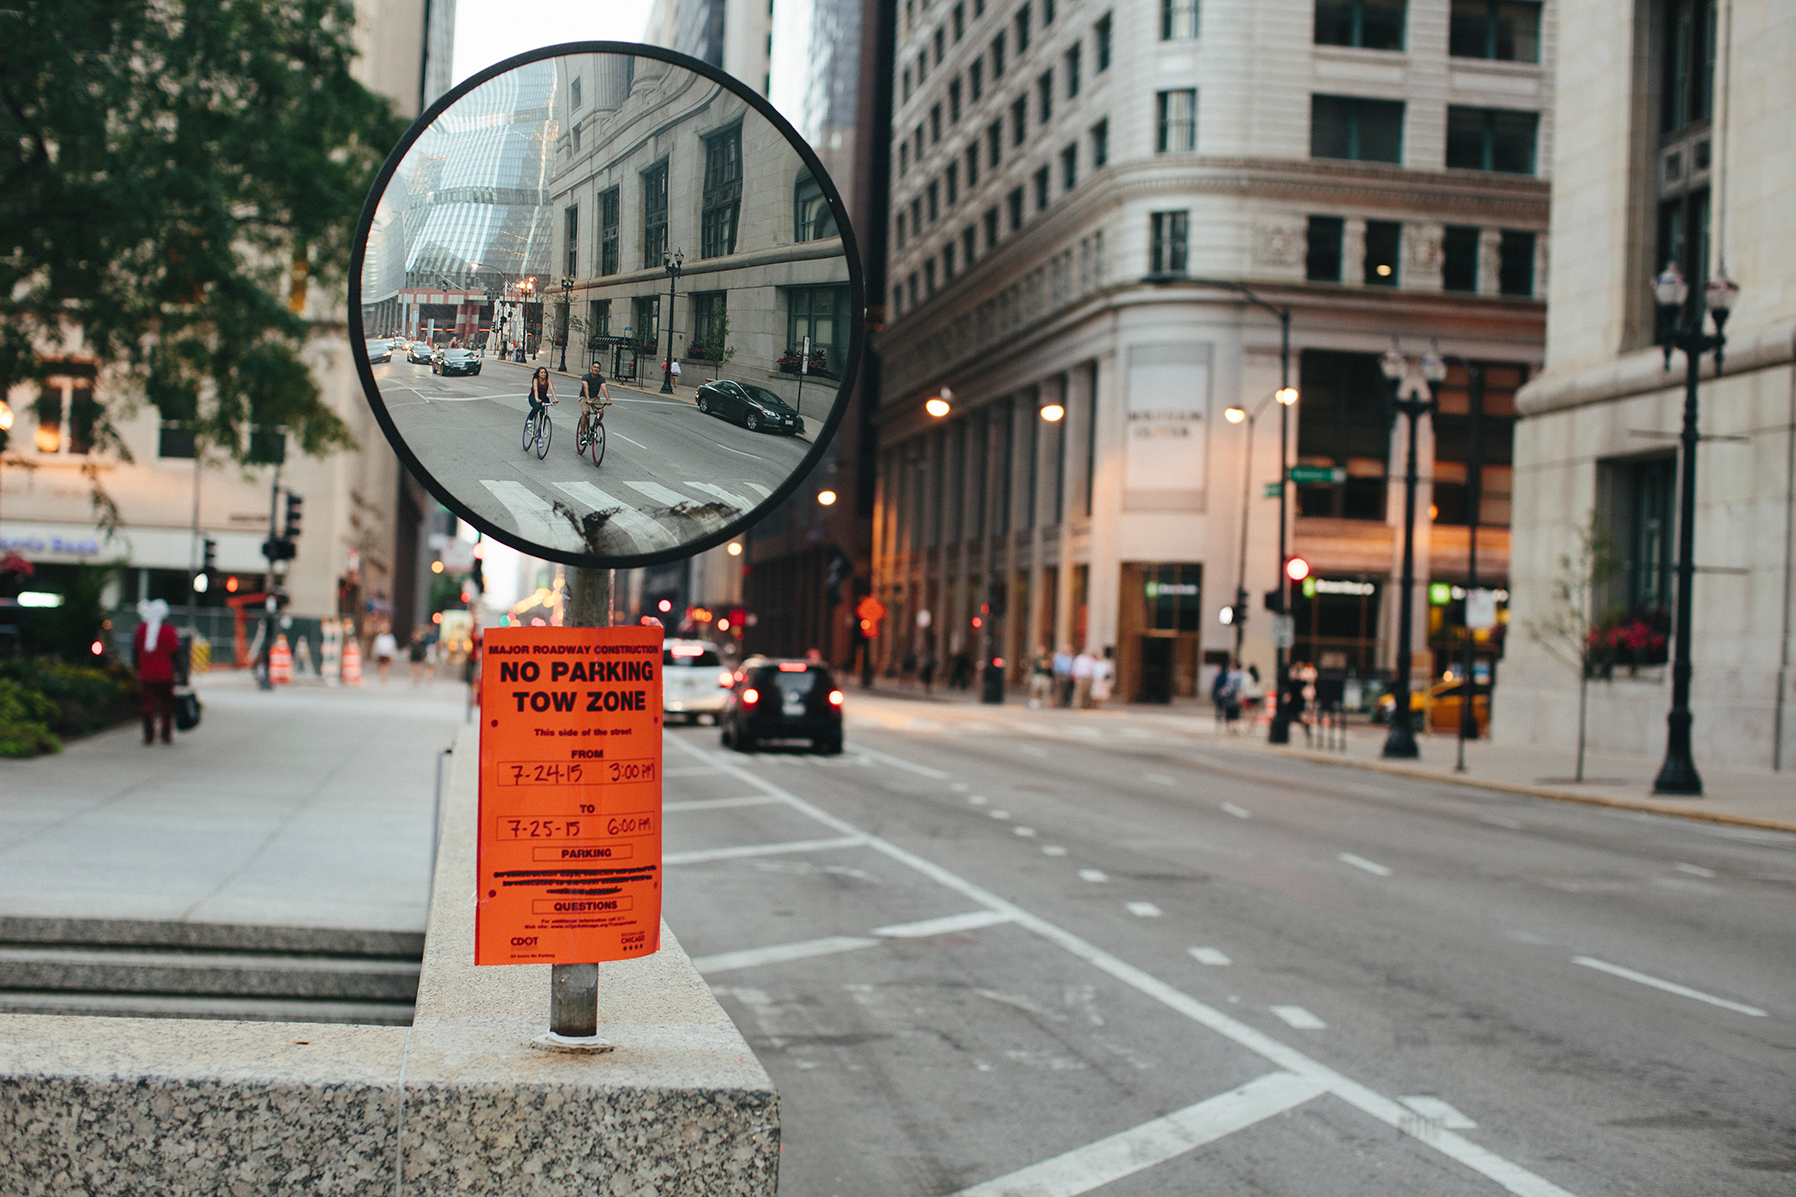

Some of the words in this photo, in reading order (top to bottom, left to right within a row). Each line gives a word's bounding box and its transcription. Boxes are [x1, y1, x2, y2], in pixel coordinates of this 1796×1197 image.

[489, 645, 529, 654] MAJOR
[533, 645, 591, 654] ROADWAY
[594, 645, 659, 654] CONSTRUCTION
[501, 661, 540, 682] NO
[551, 661, 653, 682] PARKING
[512, 691, 577, 712] TOW
[586, 691, 646, 712] ZONE
[534, 728, 555, 736] This
[558, 728, 578, 736] side
[581, 728, 591, 736] of
[594, 728, 608, 736] the
[610, 728, 632, 736] street
[571, 750, 604, 759] FROM
[511, 764, 583, 785] 7-24-15
[609, 763, 640, 782] 3:00
[580, 804, 595, 813] TO
[508, 820, 580, 838] 7-25-15
[607, 818, 636, 835] 6:00
[561, 848, 612, 859] PARKING
[554, 900, 618, 911] QUESTIONS
[510, 937, 539, 946] CDOT
